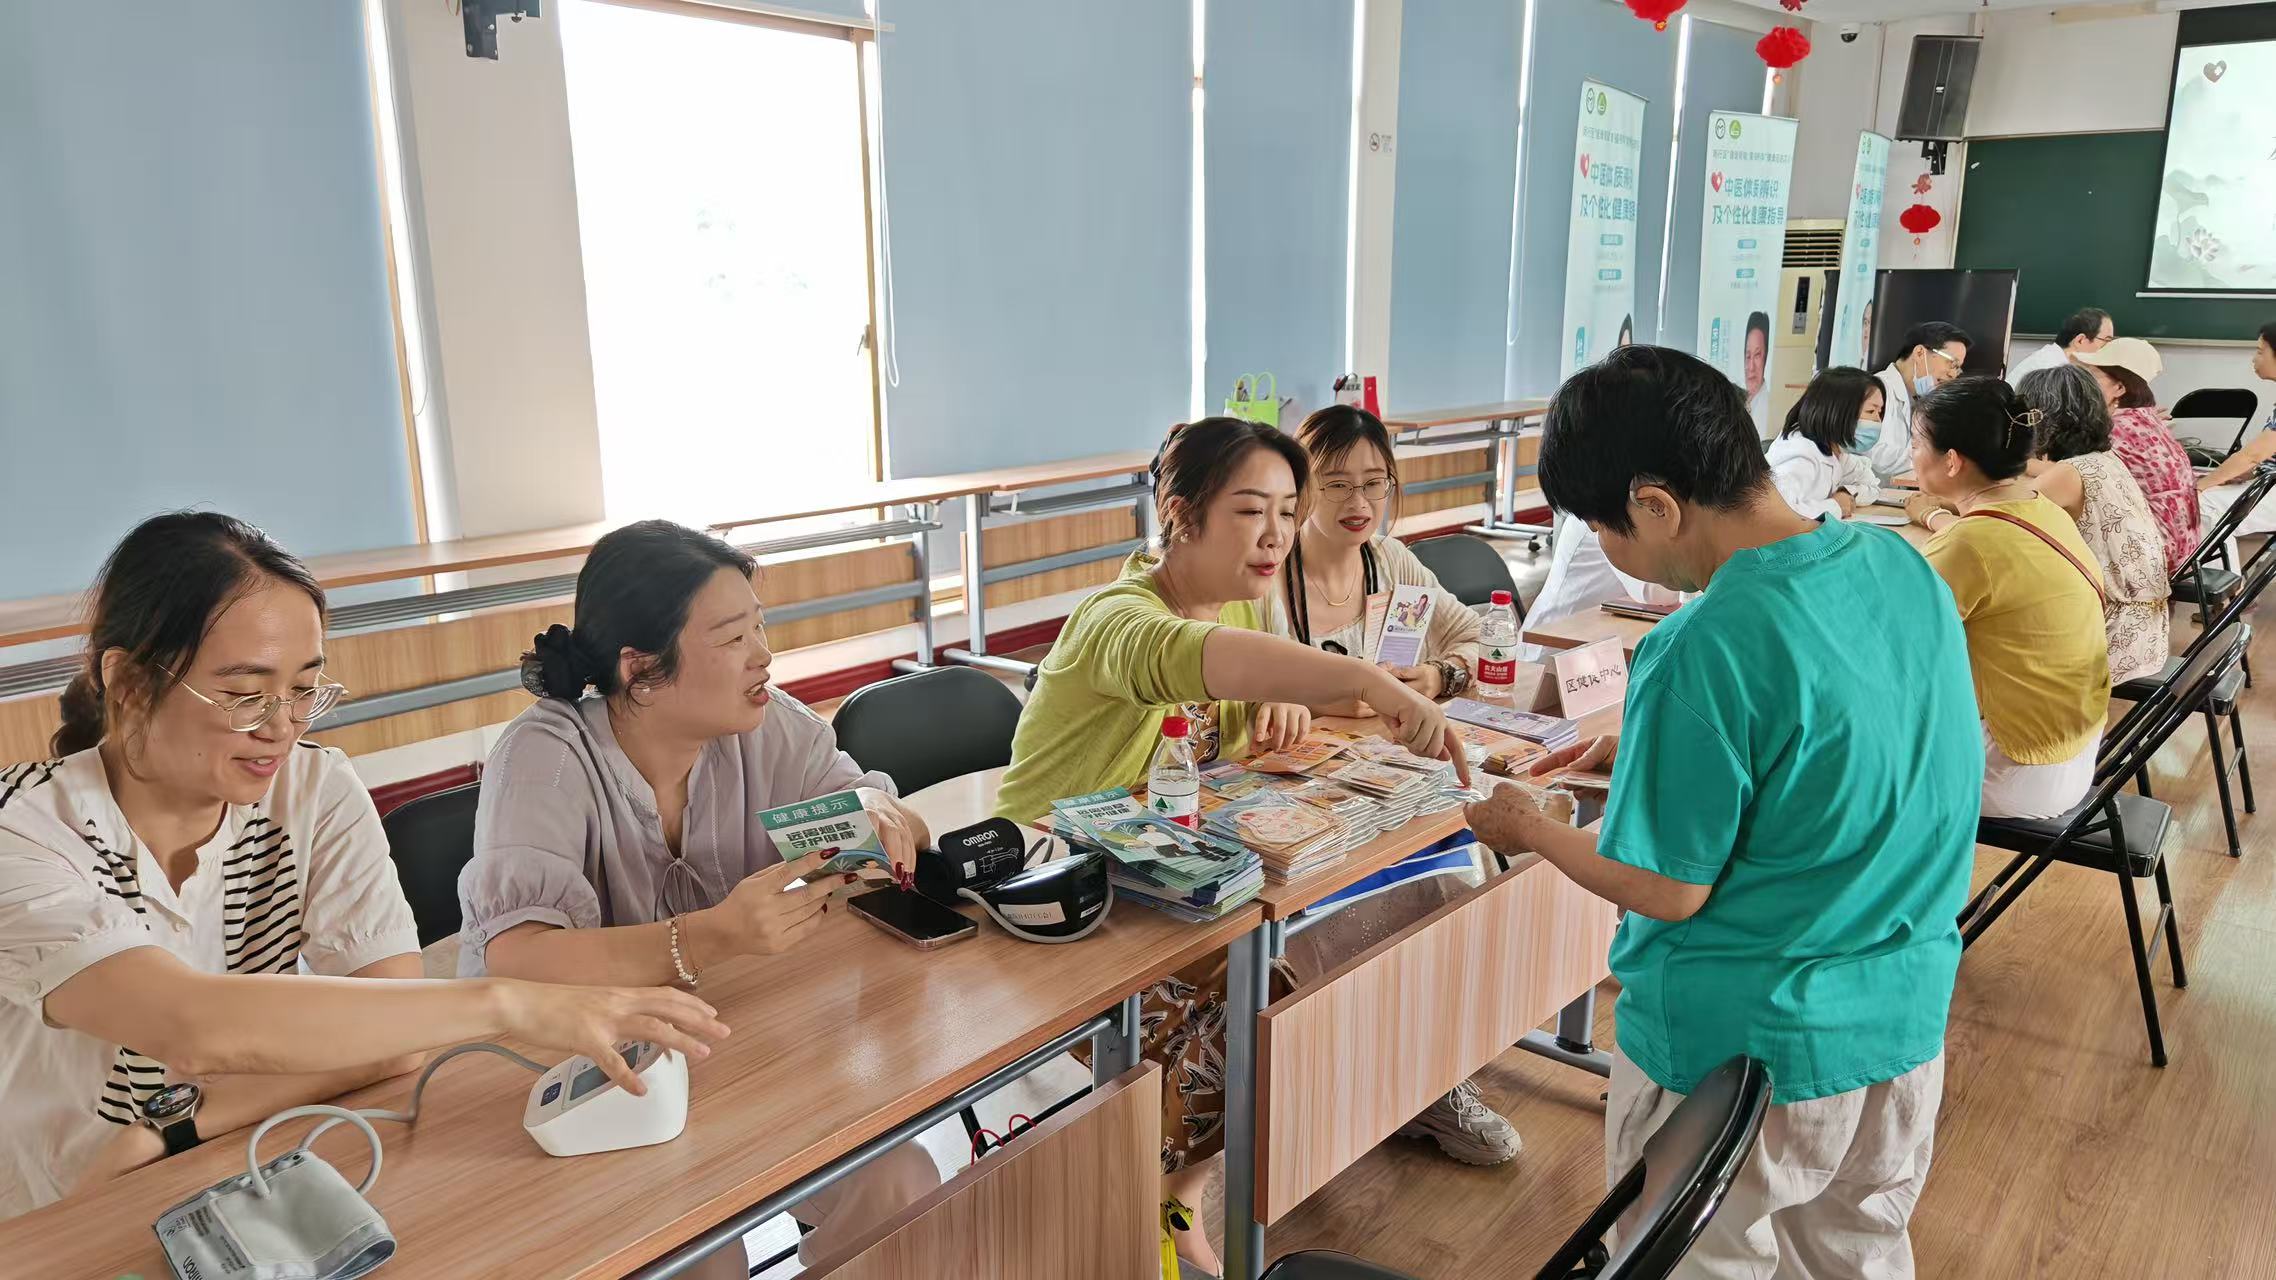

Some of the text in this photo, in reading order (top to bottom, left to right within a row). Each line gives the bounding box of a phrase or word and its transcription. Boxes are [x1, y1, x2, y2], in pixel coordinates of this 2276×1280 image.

[772, 797, 849, 824] 健康提示
[962, 829, 999, 847] OMRON
